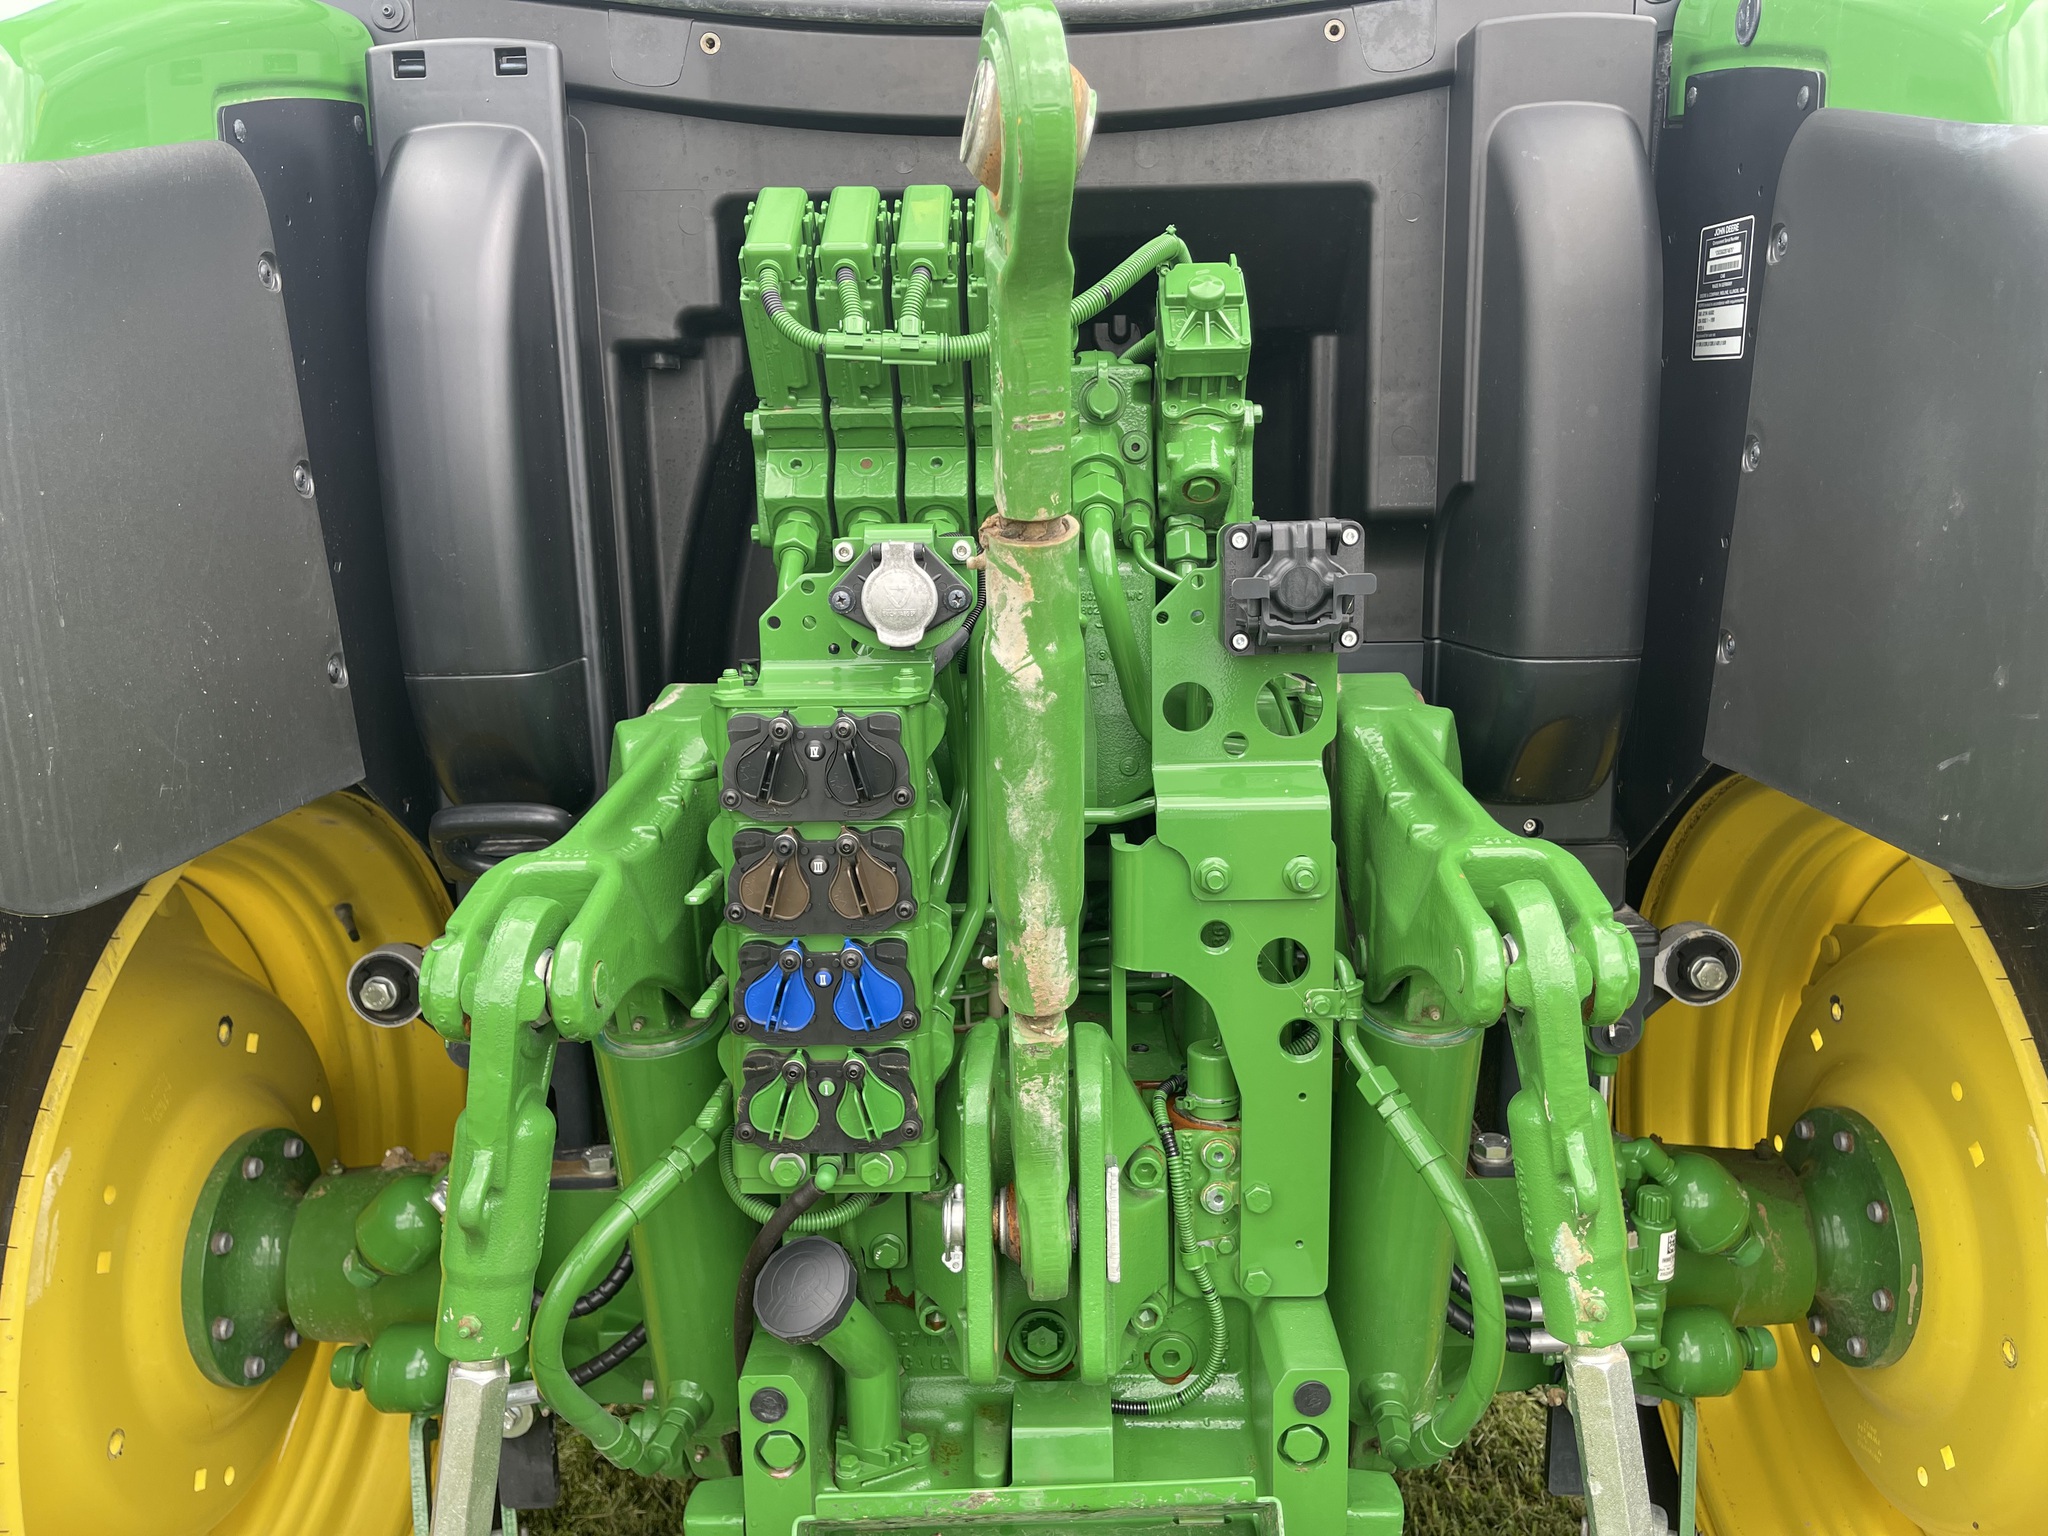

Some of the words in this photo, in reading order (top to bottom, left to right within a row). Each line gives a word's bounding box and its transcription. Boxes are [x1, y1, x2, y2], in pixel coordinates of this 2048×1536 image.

[1714, 226, 1725, 236] JOHN
[1726, 222, 1740, 234] DEERE
[810, 746, 819, 757] IV
[814, 861, 823, 872] III
[820, 974, 826, 985] II
